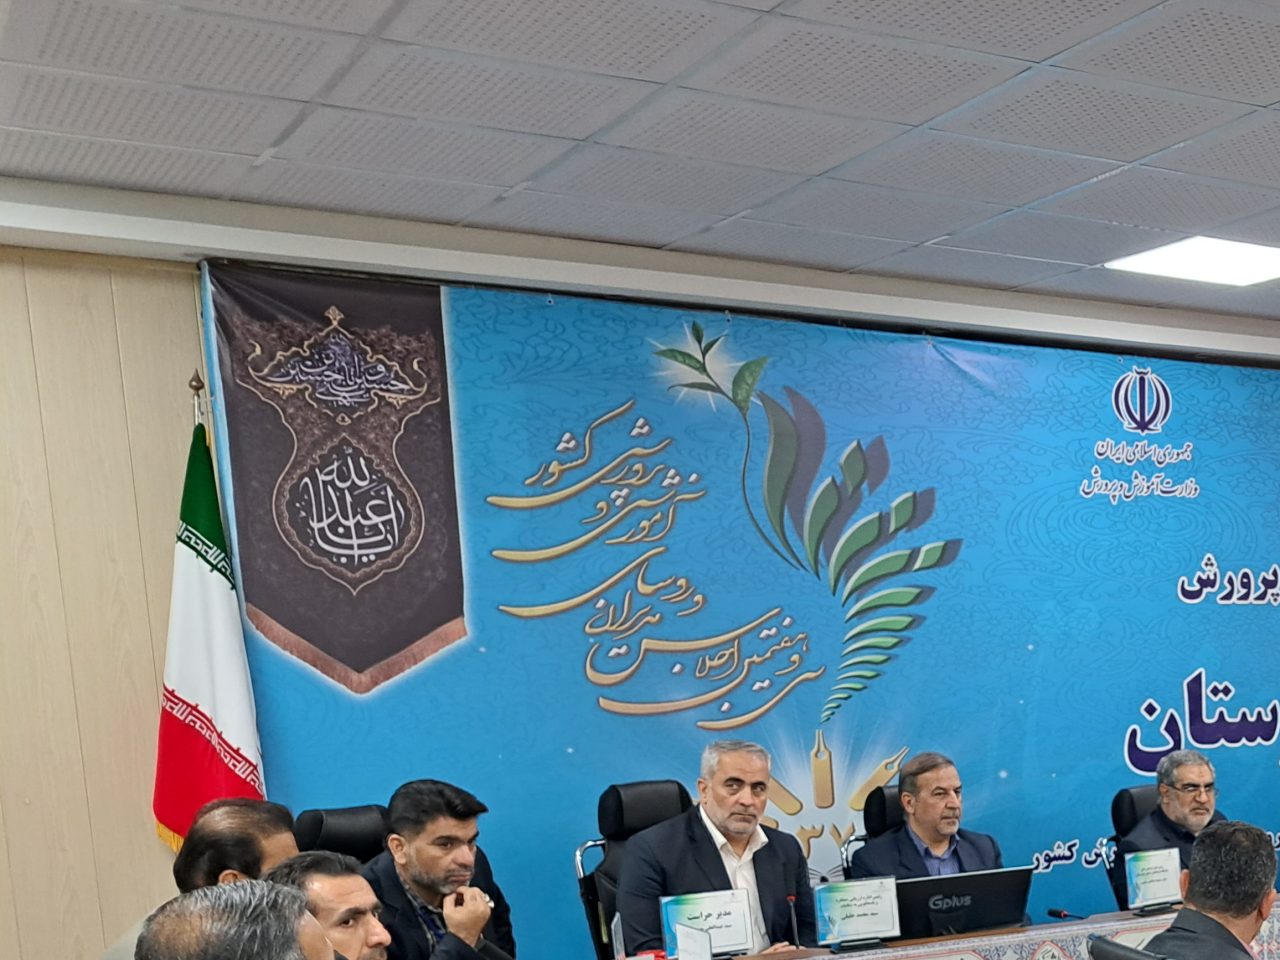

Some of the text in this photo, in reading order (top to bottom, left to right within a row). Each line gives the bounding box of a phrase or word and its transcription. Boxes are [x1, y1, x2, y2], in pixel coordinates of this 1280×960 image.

[524, 399, 635, 487] کشور
[1095, 438, 1193, 467] جمهوری اسلامی ایران
[1080, 465, 1118, 505] پرورش
[1123, 470, 1164, 500] آموزش
[1160, 478, 1200, 497] وزارت
[1179, 553, 1280, 606] پرورش
[1031, 838, 1080, 874] کشور
[928, 894, 972, 910] Gplus
